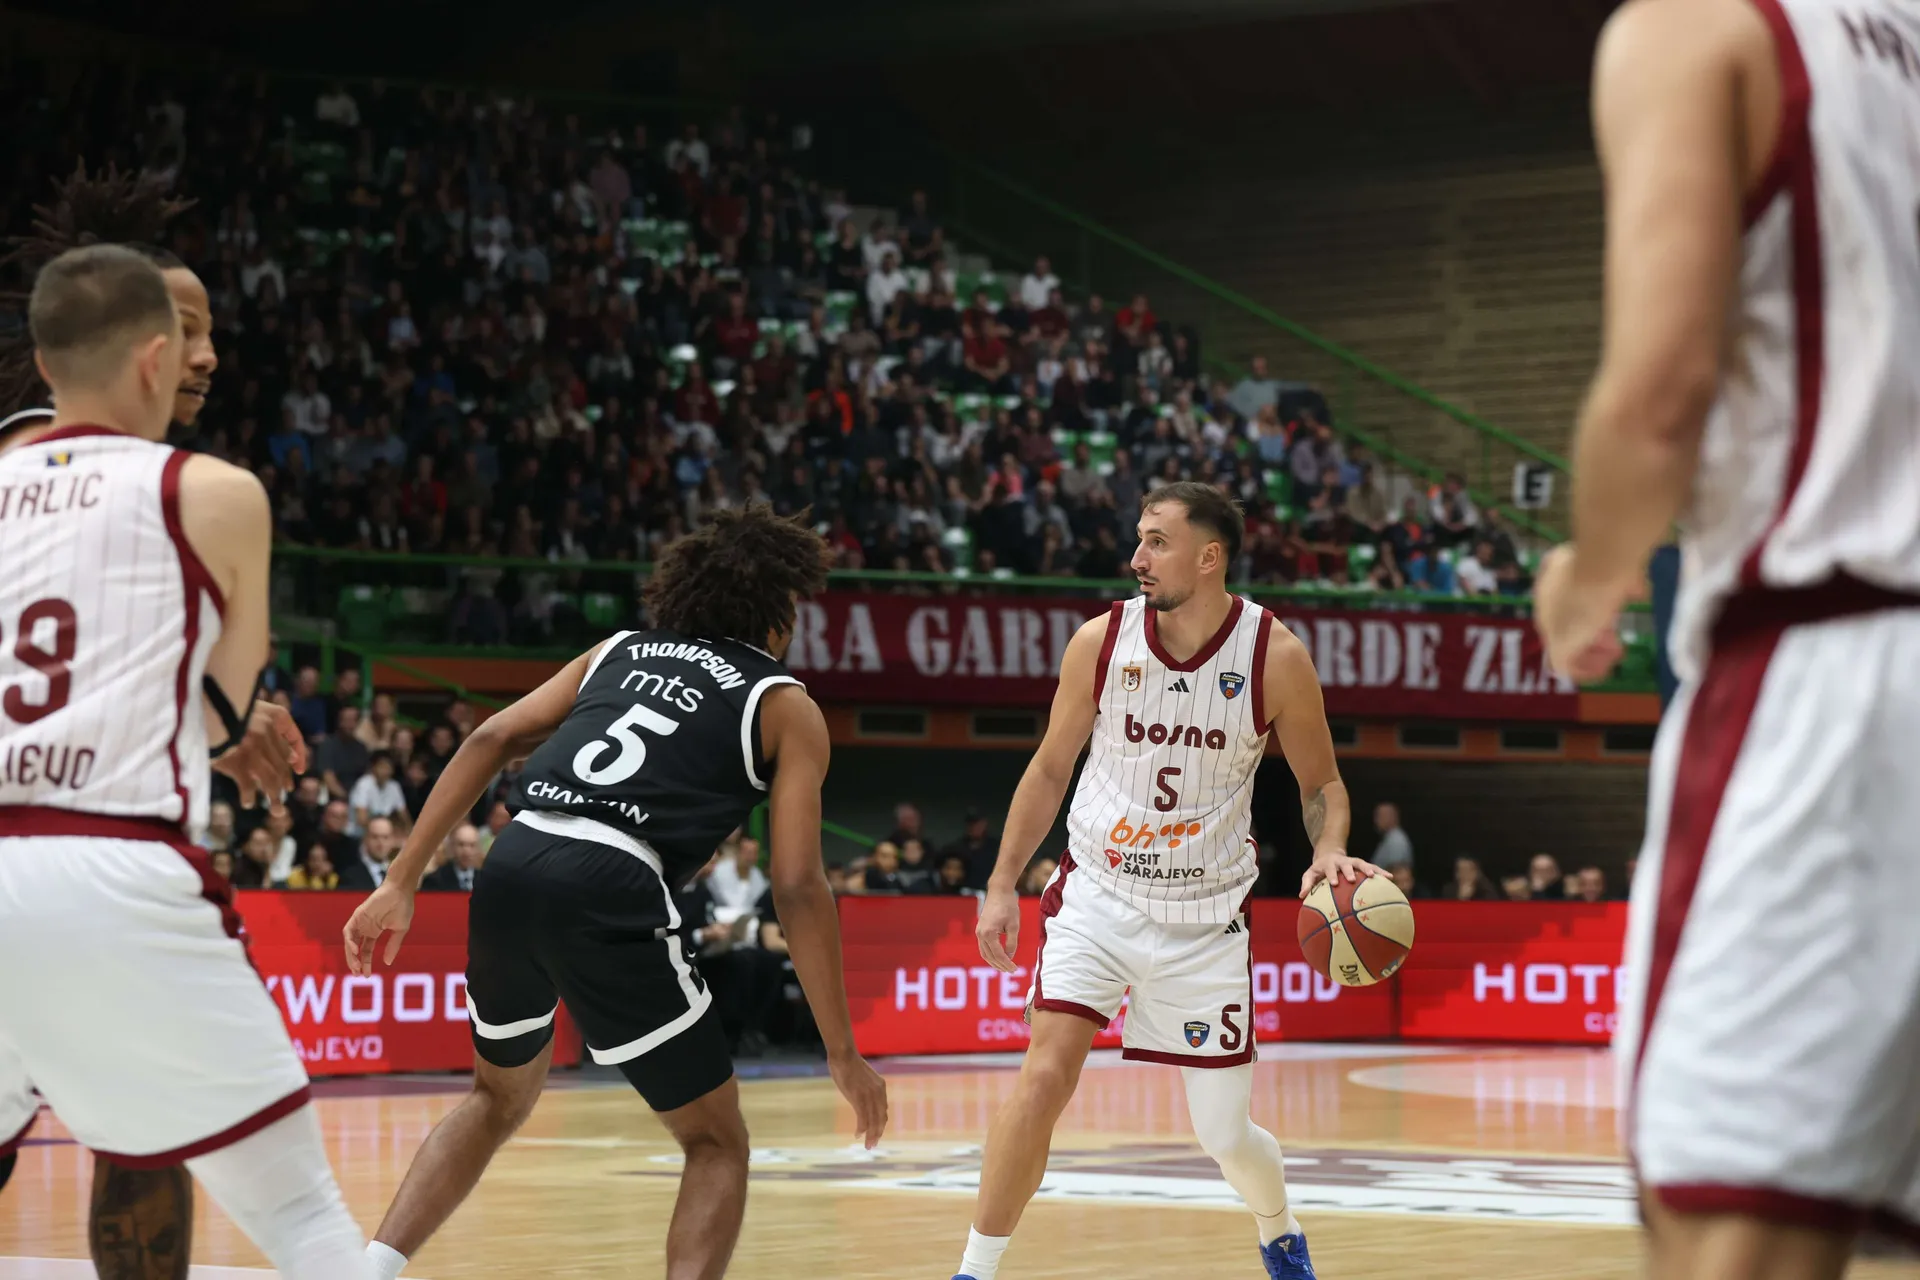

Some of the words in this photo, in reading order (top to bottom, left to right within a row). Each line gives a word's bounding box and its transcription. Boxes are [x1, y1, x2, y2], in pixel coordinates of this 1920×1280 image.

[1525, 467, 1548, 501] E
[0, 598, 77, 724] 9
[627, 642, 746, 690] THOMPSON
[620, 669, 704, 713] mts
[572, 703, 680, 786] 5
[1125, 714, 1227, 750] bosna
[1122, 852, 1161, 866] VISIT
[1122, 861, 1205, 880] SARAJEVO
[266, 972, 469, 1025] WOOD
[895, 966, 1036, 1011] HOTE
